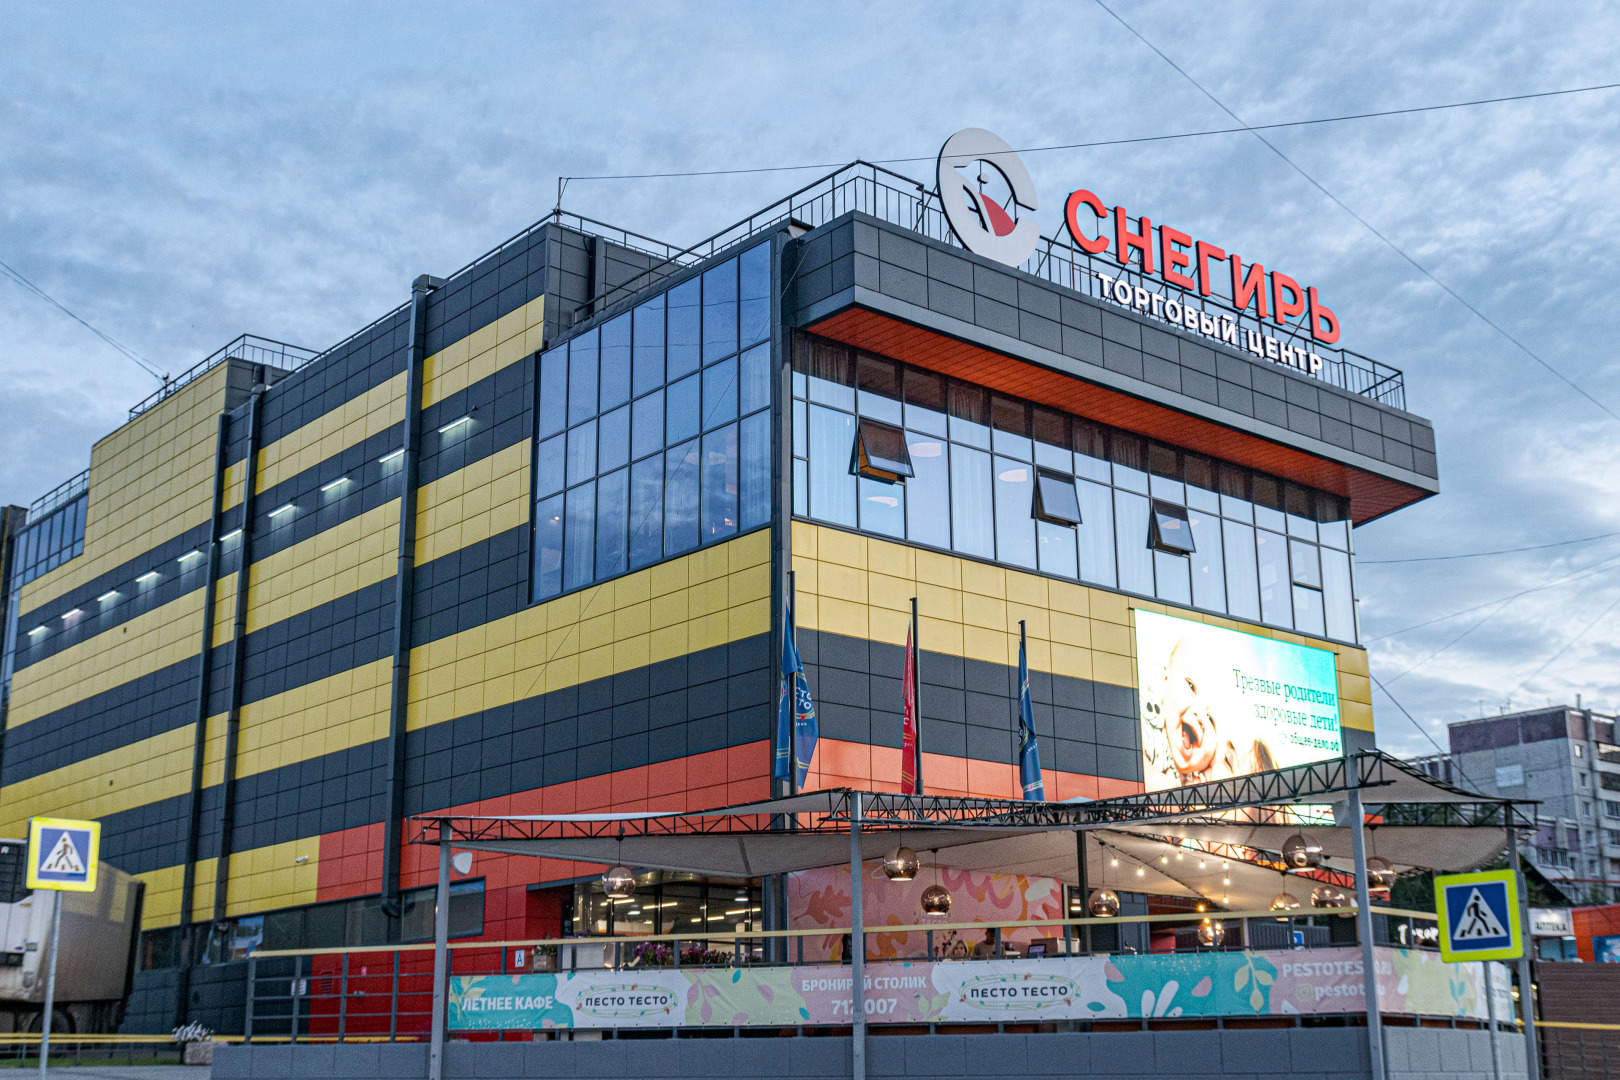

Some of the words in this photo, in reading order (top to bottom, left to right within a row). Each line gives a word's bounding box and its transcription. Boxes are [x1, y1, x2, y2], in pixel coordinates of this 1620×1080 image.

[1064, 189, 1340, 344] СНЕГИРЬ
[1097, 273, 1236, 345] ТОРГОВЫЙ
[1246, 329, 1323, 374] ЦЕНТР
[1232, 668, 1281, 696] Трезвые
[1283, 684, 1336, 707] родители
[1253, 704, 1307, 726] здоровые
[1310, 713, 1339, 732] дети!
[802, 974, 872, 992] БРОНИРЙ
[874, 976, 927, 990] СТОЛИК
[971, 987, 1018, 998] ПЕСТО
[1021, 986, 1068, 997] ТЕСТО
[461, 996, 513, 1011] ЛЕТНЕЕ
[515, 995, 553, 1010] КАФЕ
[585, 997, 625, 1007] ПЕСТО
[628, 995, 668, 1006] ТЕСТО
